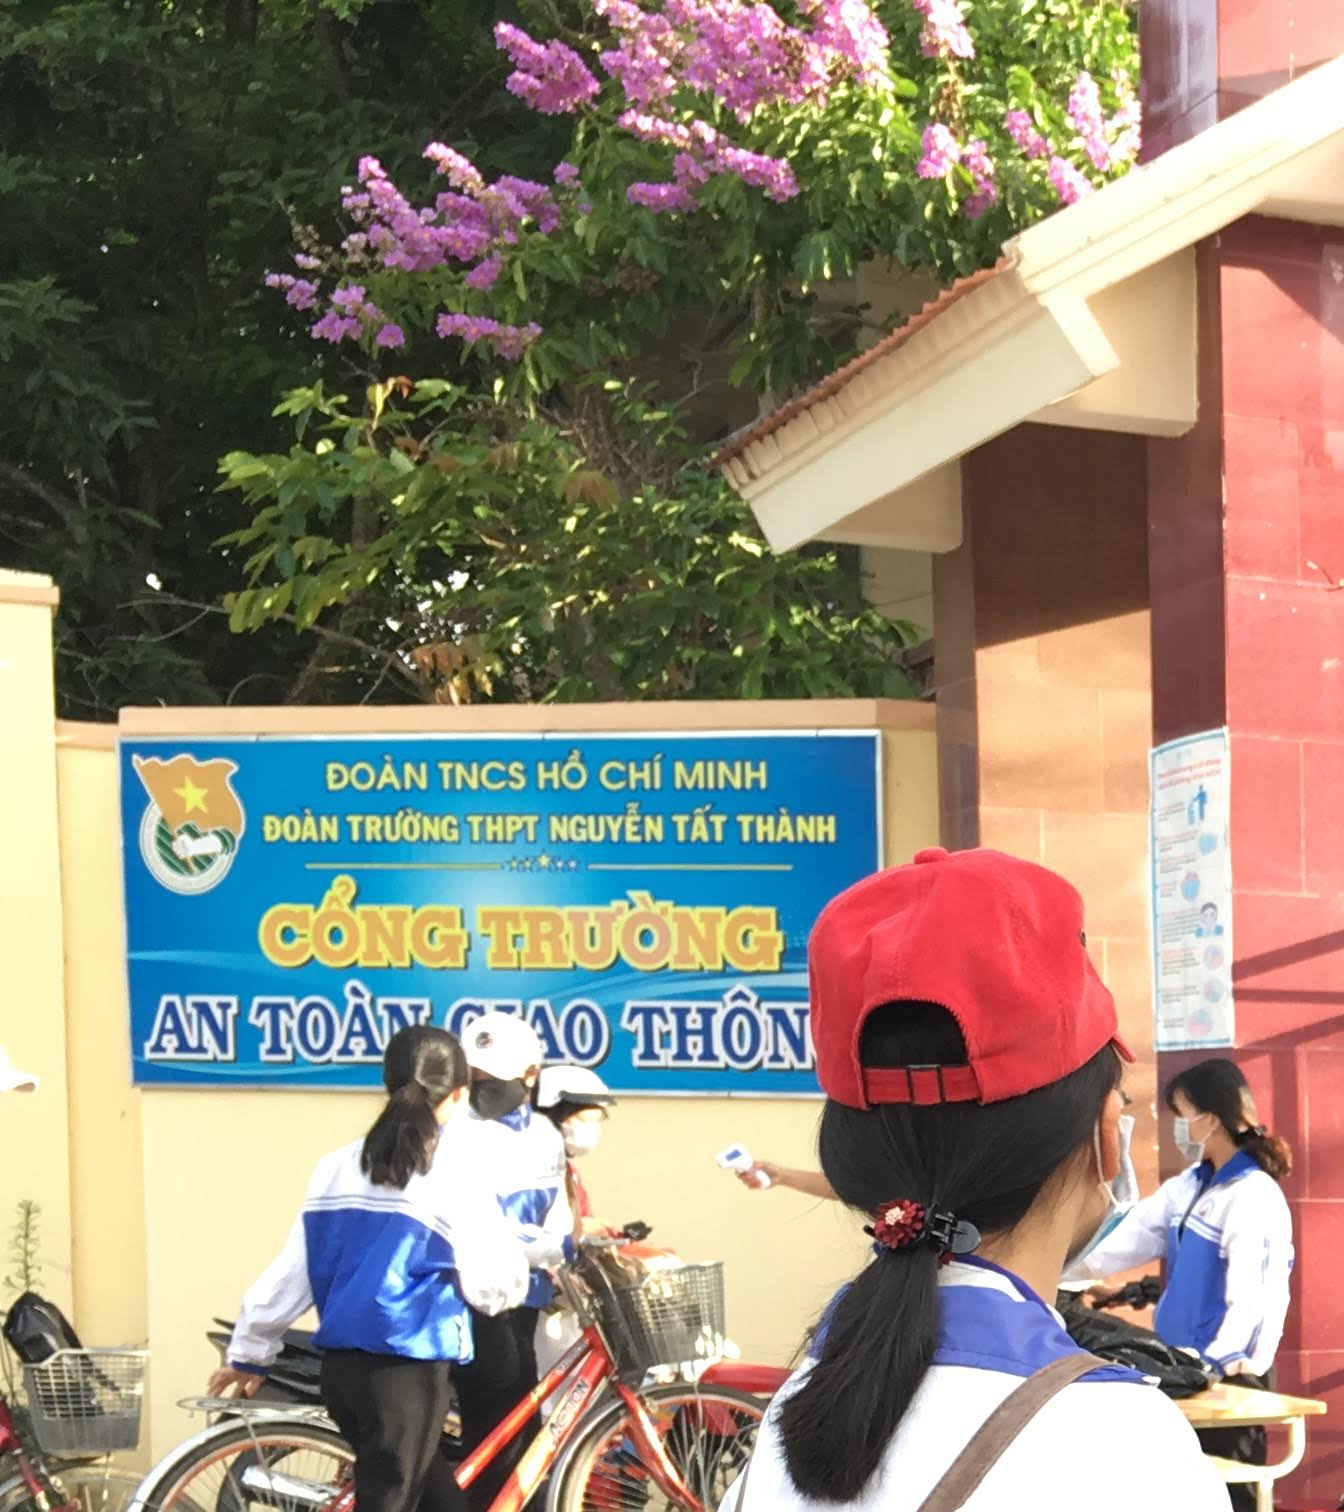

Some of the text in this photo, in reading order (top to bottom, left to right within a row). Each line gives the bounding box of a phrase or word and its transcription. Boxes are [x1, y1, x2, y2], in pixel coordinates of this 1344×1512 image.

[326, 753, 428, 791] ĐOÀN
[438, 761, 527, 790] TNCS
[599, 753, 662, 790] CHÍ
[674, 761, 768, 790] MINH
[262, 801, 837, 843] ĐOÀN TRƯỜNG THPT NGUYỄN TẤT THÀNH
[258, 875, 783, 971] CỔNG TRƯỜNG
[145, 994, 238, 1063] AN
[446, 998, 611, 1067] GAO
[620, 983, 813, 1069] THÔN
